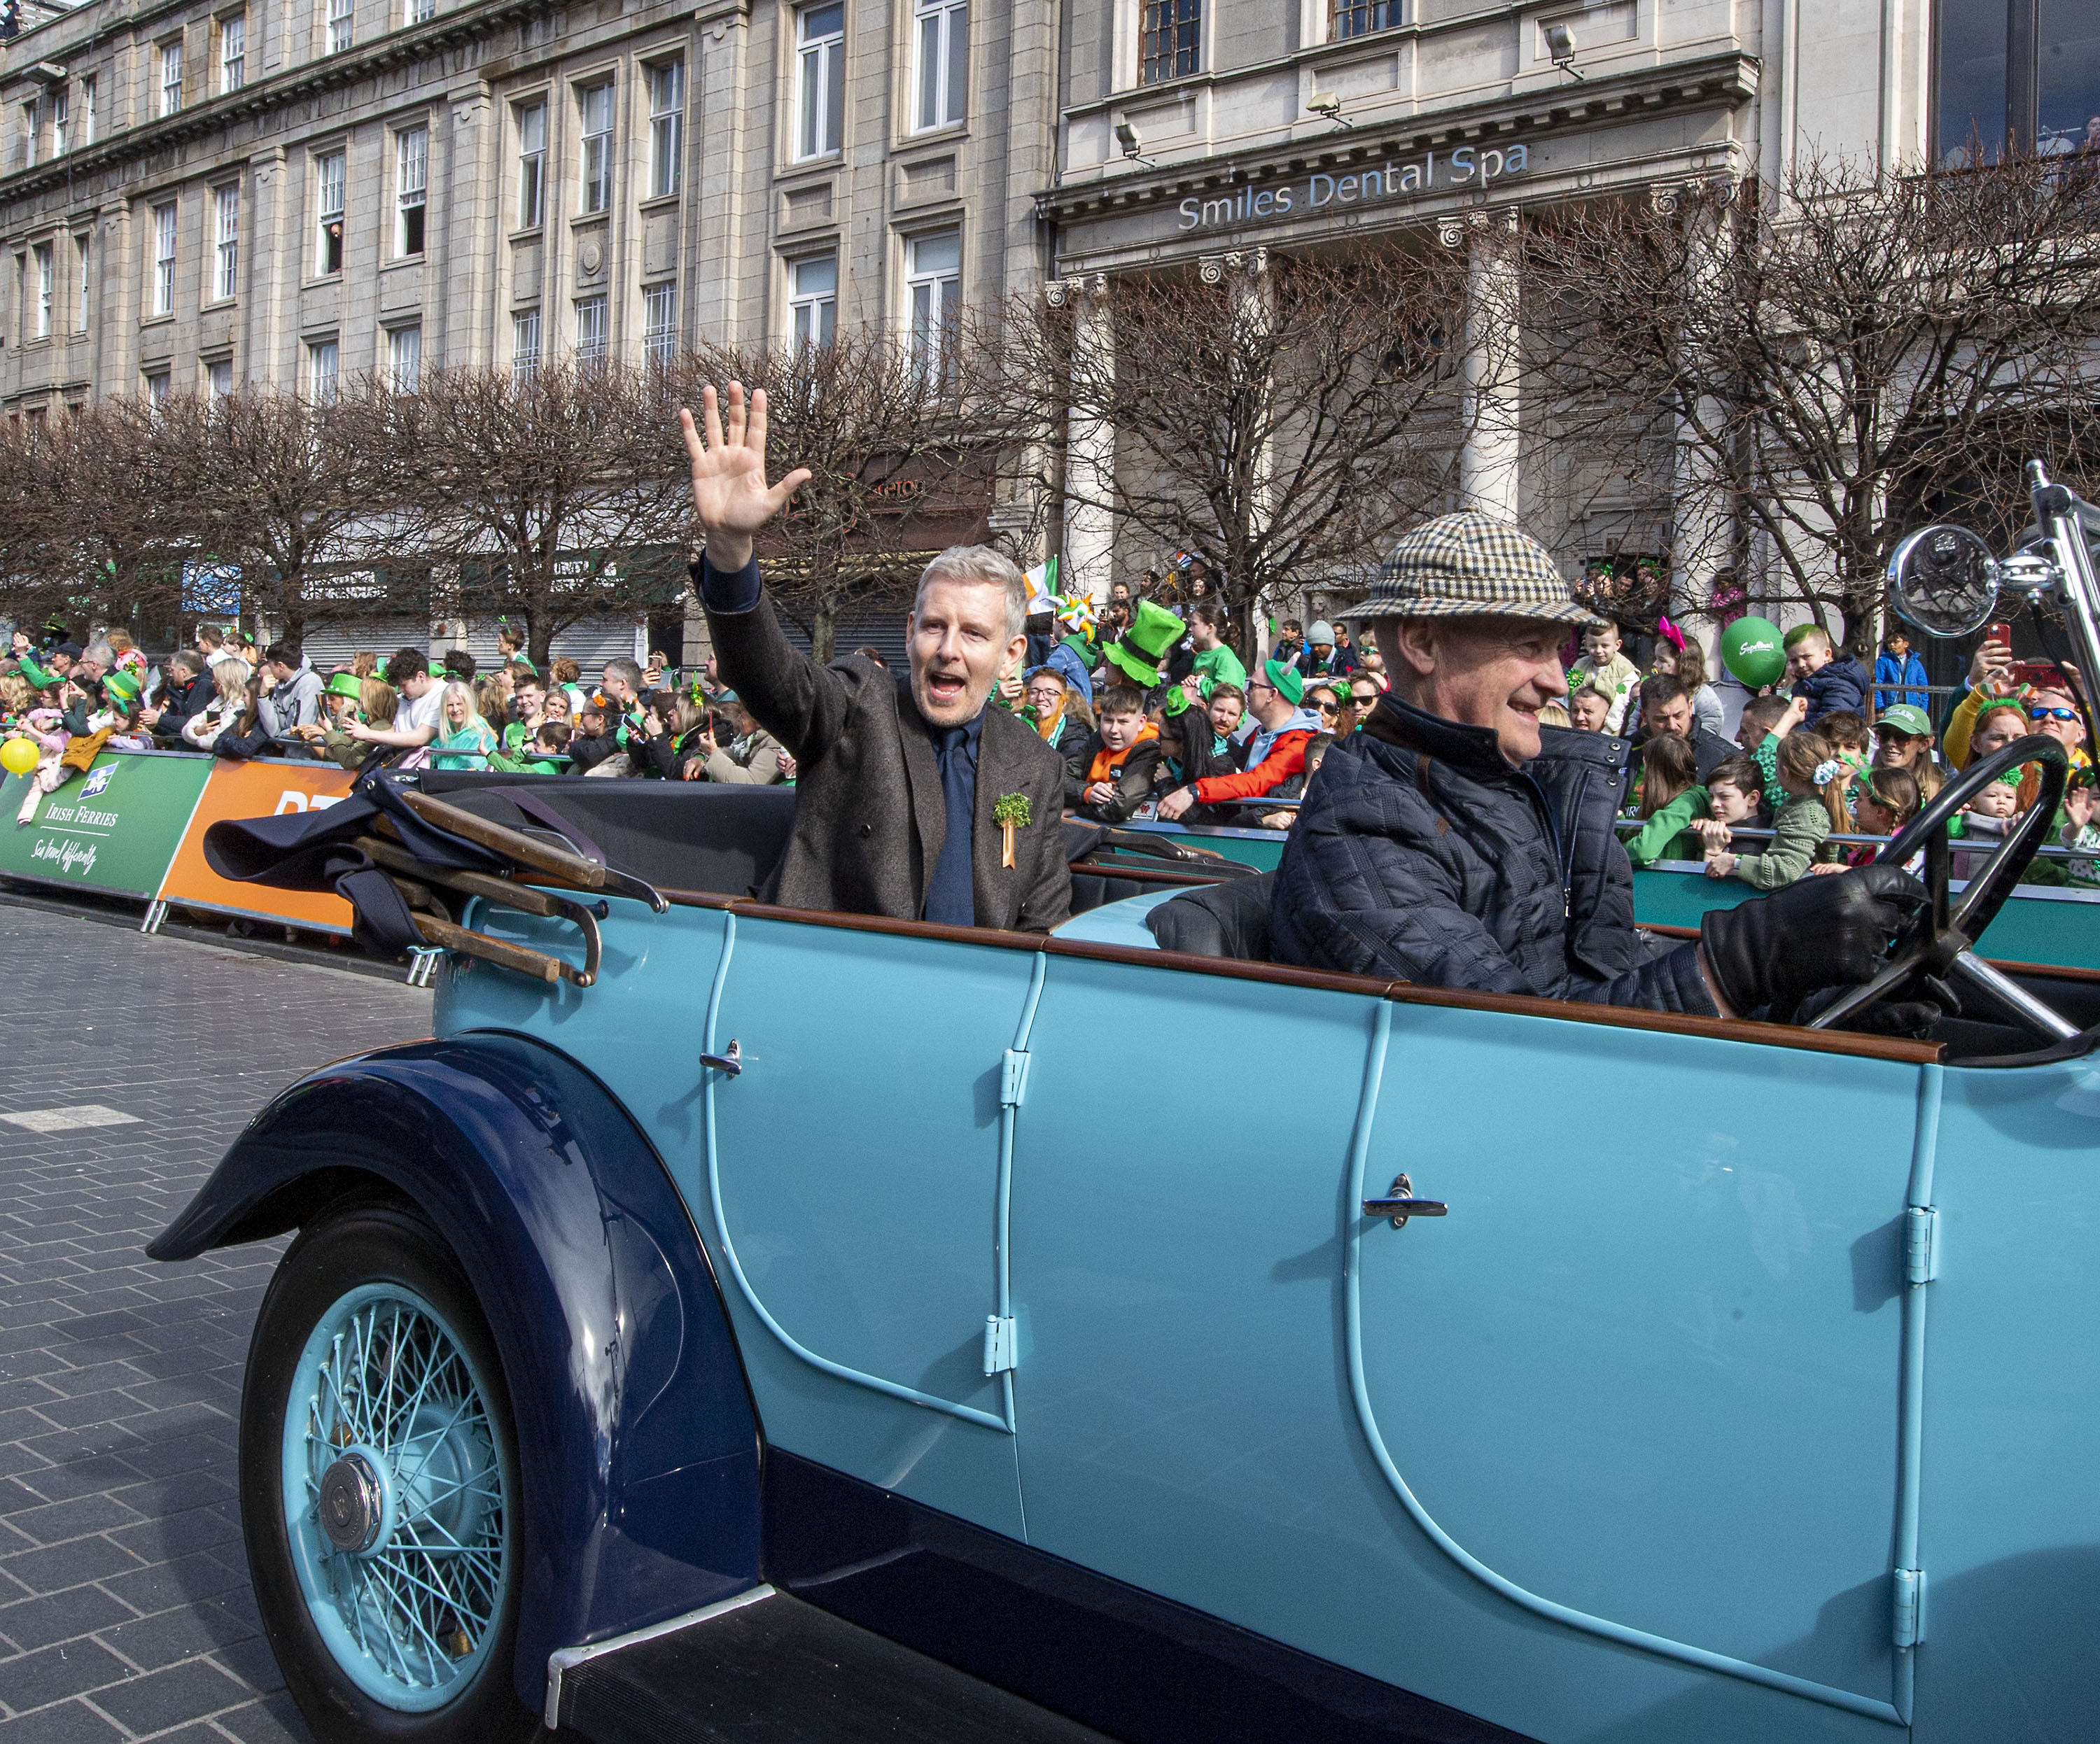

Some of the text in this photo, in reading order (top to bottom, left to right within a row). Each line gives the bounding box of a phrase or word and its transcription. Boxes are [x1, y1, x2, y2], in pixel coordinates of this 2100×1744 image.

[1178, 144, 1528, 232] Smiles Dental Spa
[45, 803, 118, 827] IRISH FERRIES
[31, 839, 46, 858] Sea
[62, 841, 97, 875] differently
